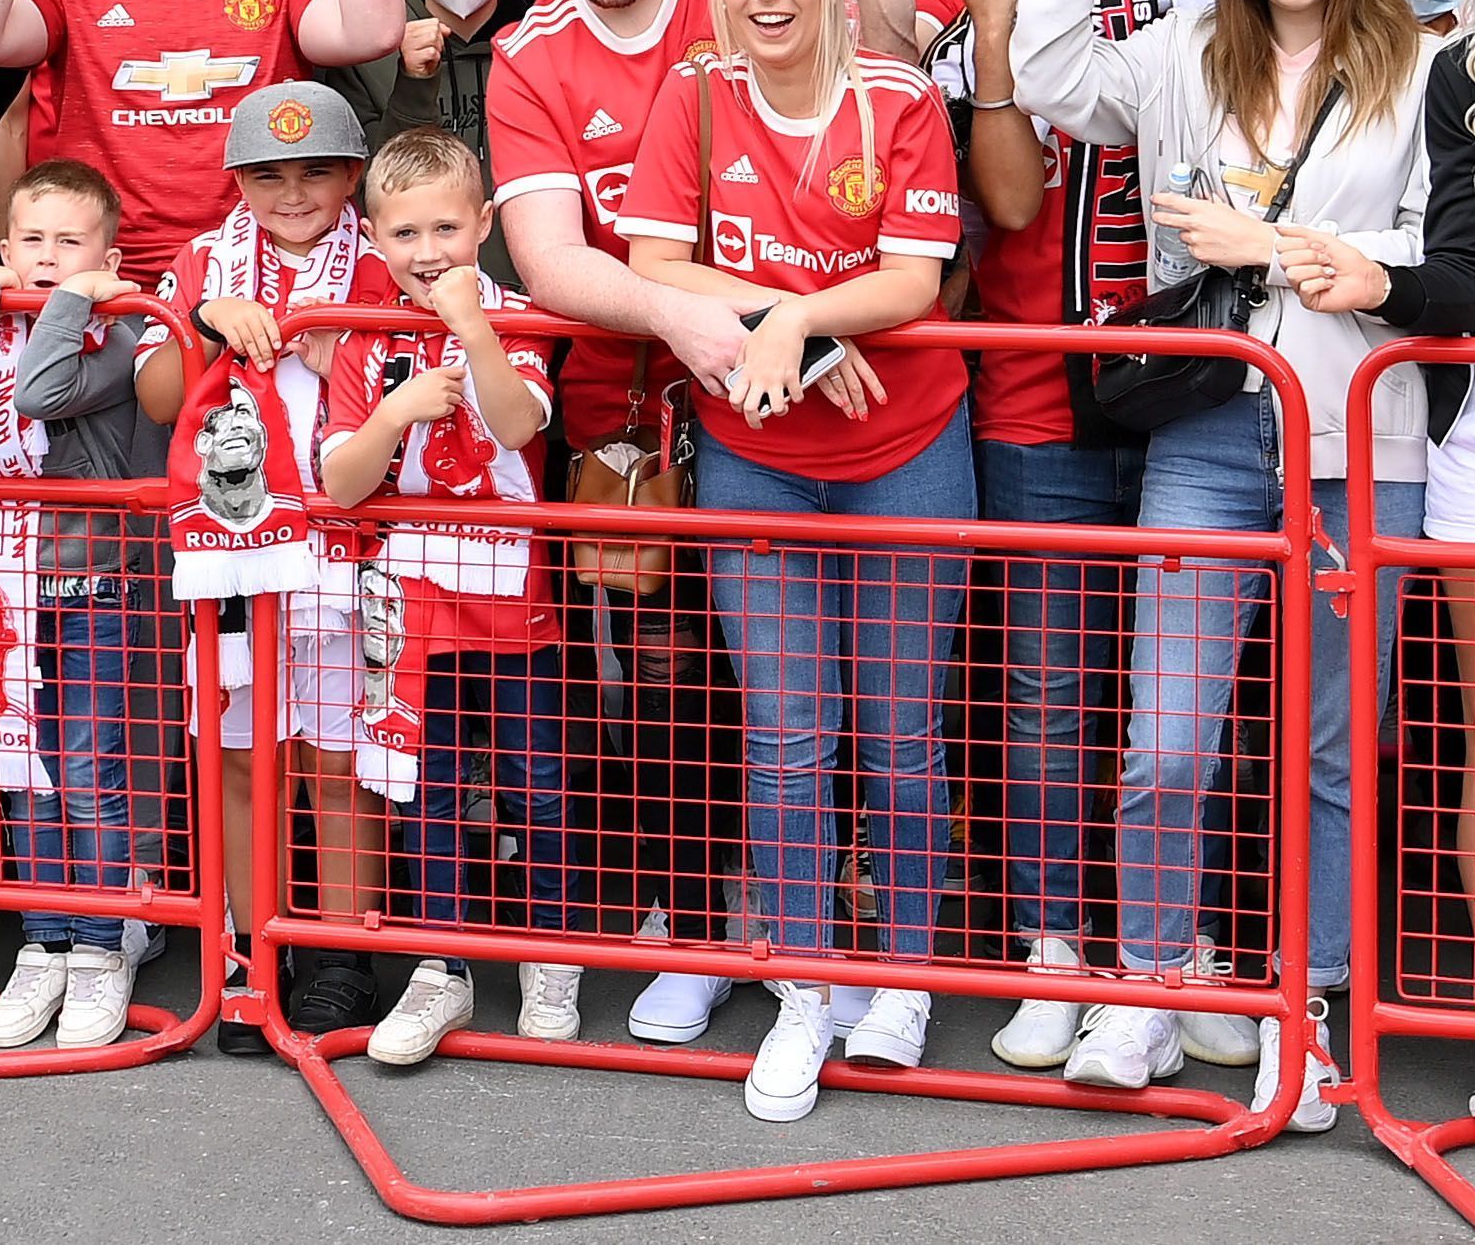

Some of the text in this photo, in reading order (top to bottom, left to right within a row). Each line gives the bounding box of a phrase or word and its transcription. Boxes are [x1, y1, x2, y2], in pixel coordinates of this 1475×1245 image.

[111, 107, 236, 127] CHEVROL
[582, 122, 624, 141] adidas
[753, 232, 879, 274] TeamView
[184, 524, 294, 550] RONALDO
